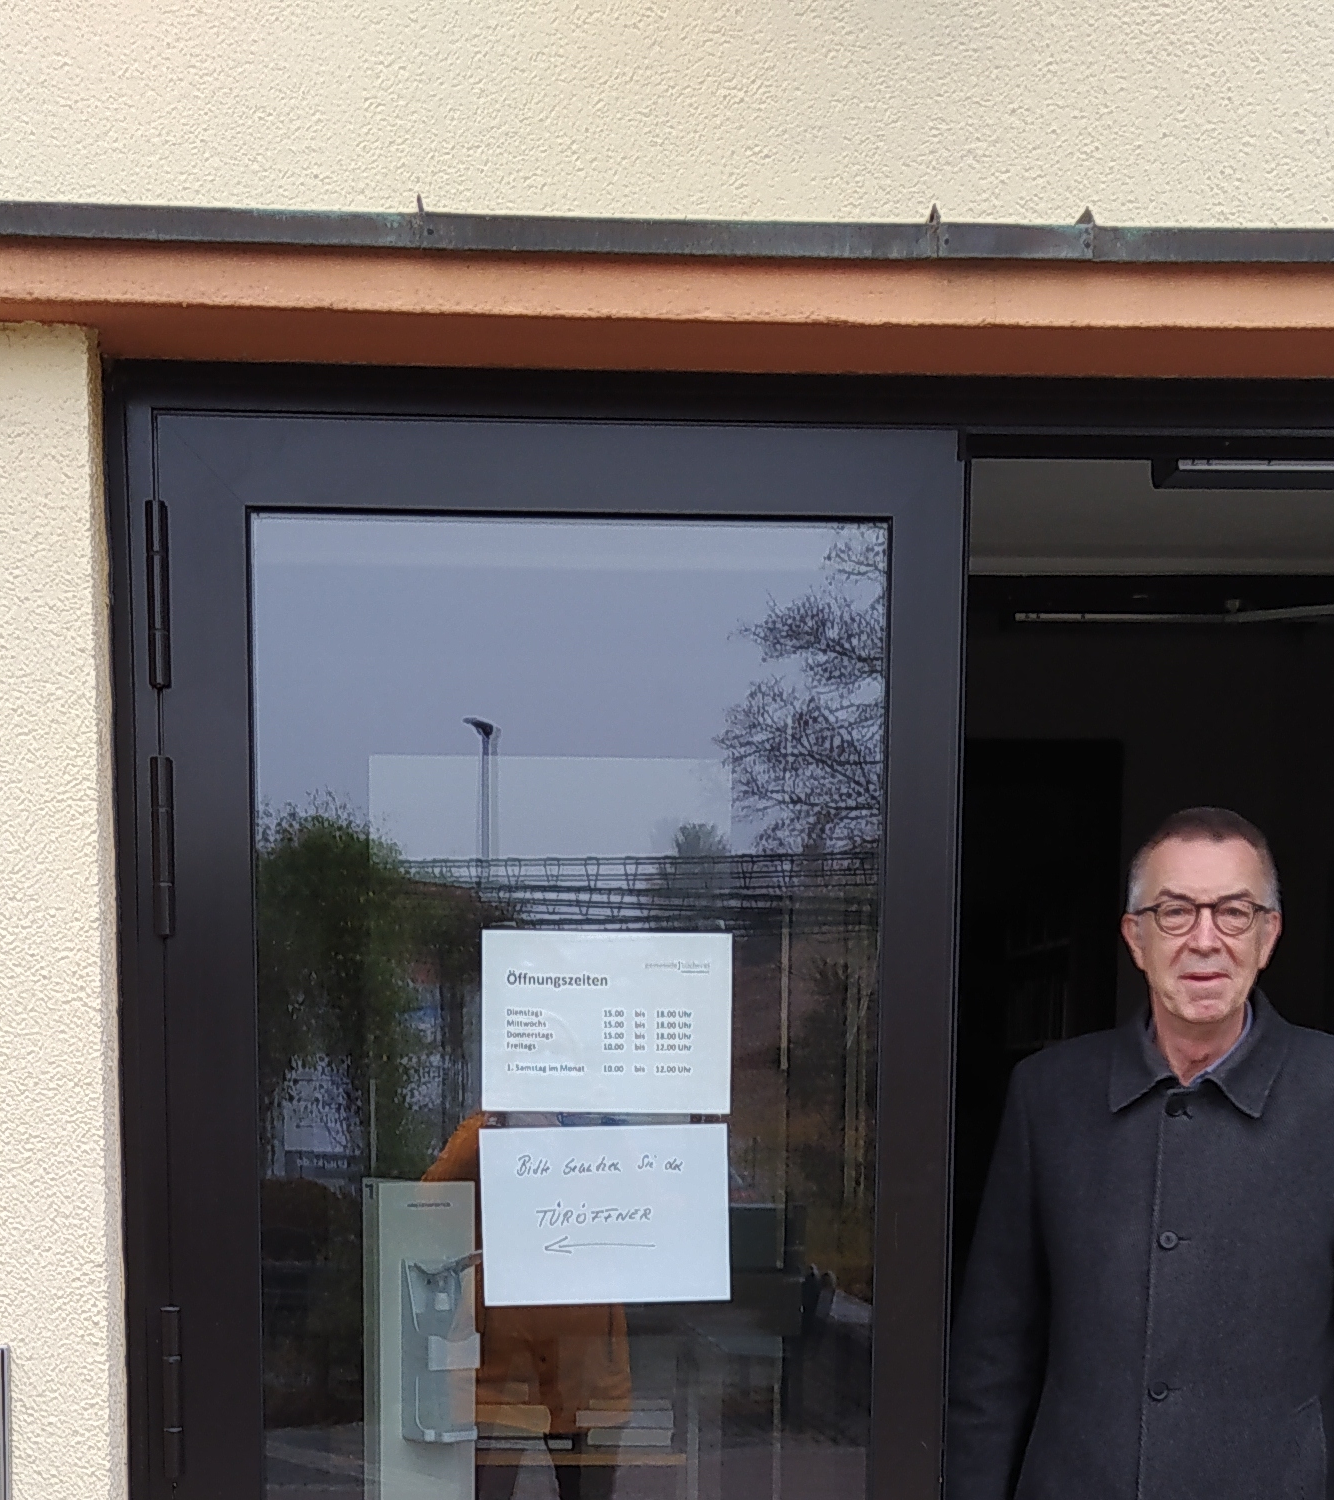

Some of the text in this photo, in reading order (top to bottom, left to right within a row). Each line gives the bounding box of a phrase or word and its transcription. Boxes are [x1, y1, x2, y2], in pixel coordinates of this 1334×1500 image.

[506, 969, 608, 989] Öffnungszeiten
[506, 1008, 543, 1018] Dienstags
[634, 1009, 646, 1018] bis
[678, 1009, 692, 1018] Uhr
[506, 1019, 547, 1028] Mittwochs
[634, 1020, 646, 1029] bis
[678, 1020, 692, 1029] Uhr
[506, 1030, 554, 1041] Donnerstags
[634, 1031, 646, 1040] bis
[678, 1031, 692, 1040] Uhr
[506, 1042, 537, 1051] Freitags
[634, 1043, 646, 1051] bis
[678, 1043, 692, 1051] Uhr
[515, 1063, 547, 1073] Samstag
[548, 1064, 559, 1073] im
[559, 1064, 585, 1073] Monat
[634, 1065, 646, 1073] bis
[678, 1065, 692, 1073] Uhr
[516, 1154, 551, 1177] Bitte
[637, 1154, 658, 1170] Sie
[536, 1201, 652, 1228] TÜRÖFFNER
